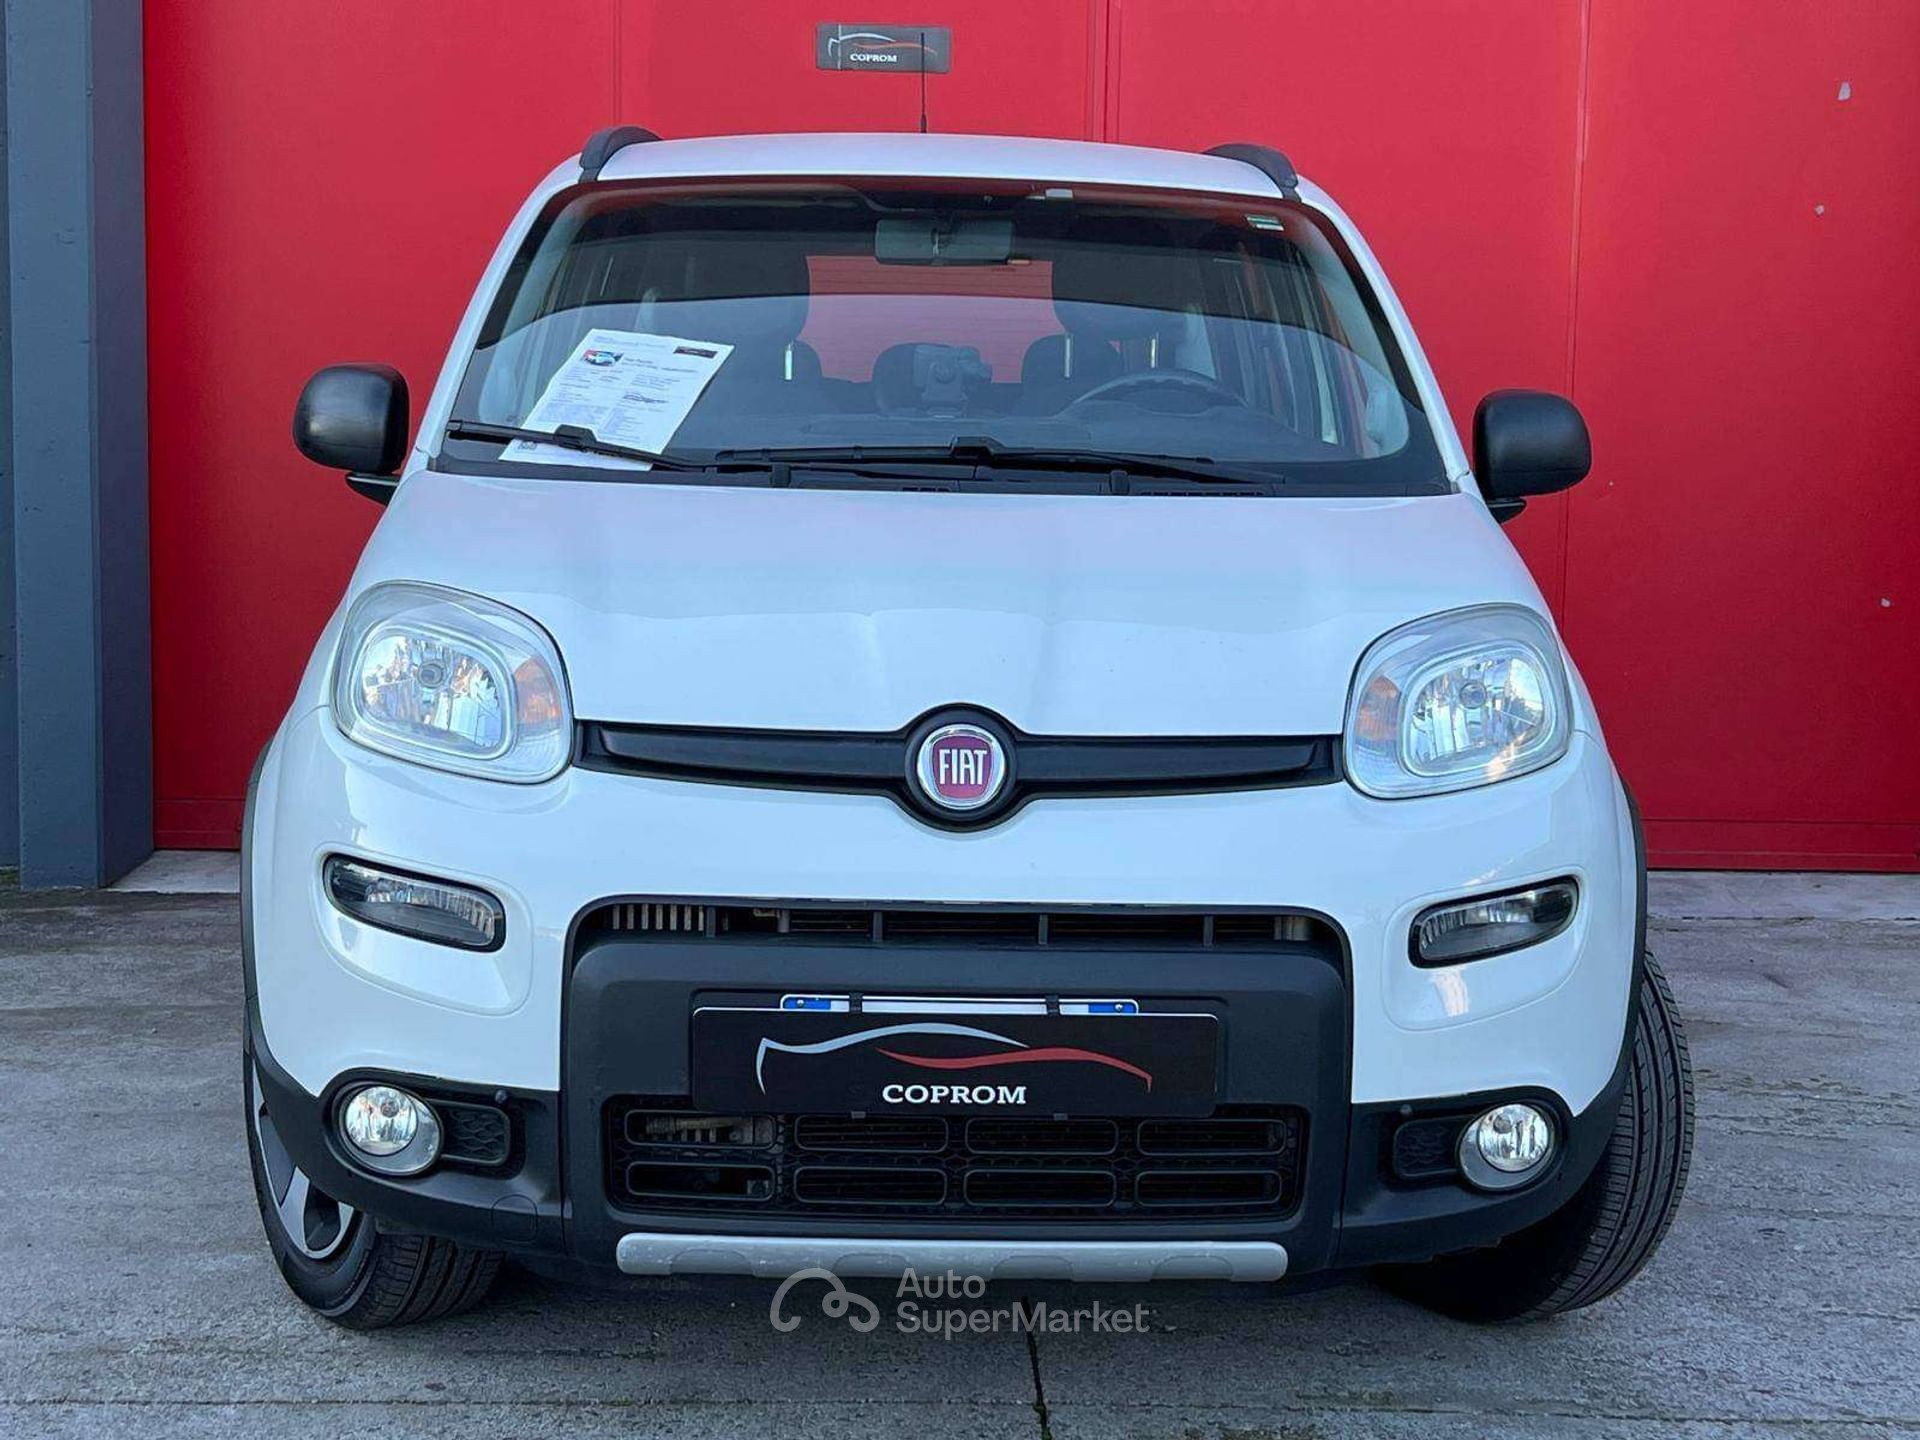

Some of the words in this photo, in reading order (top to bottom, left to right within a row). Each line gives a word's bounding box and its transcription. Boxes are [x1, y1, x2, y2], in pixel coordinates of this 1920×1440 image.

[849, 53, 898, 62] COPROM
[938, 749, 987, 785] FIAT
[882, 1084, 1027, 1104] COPROM
